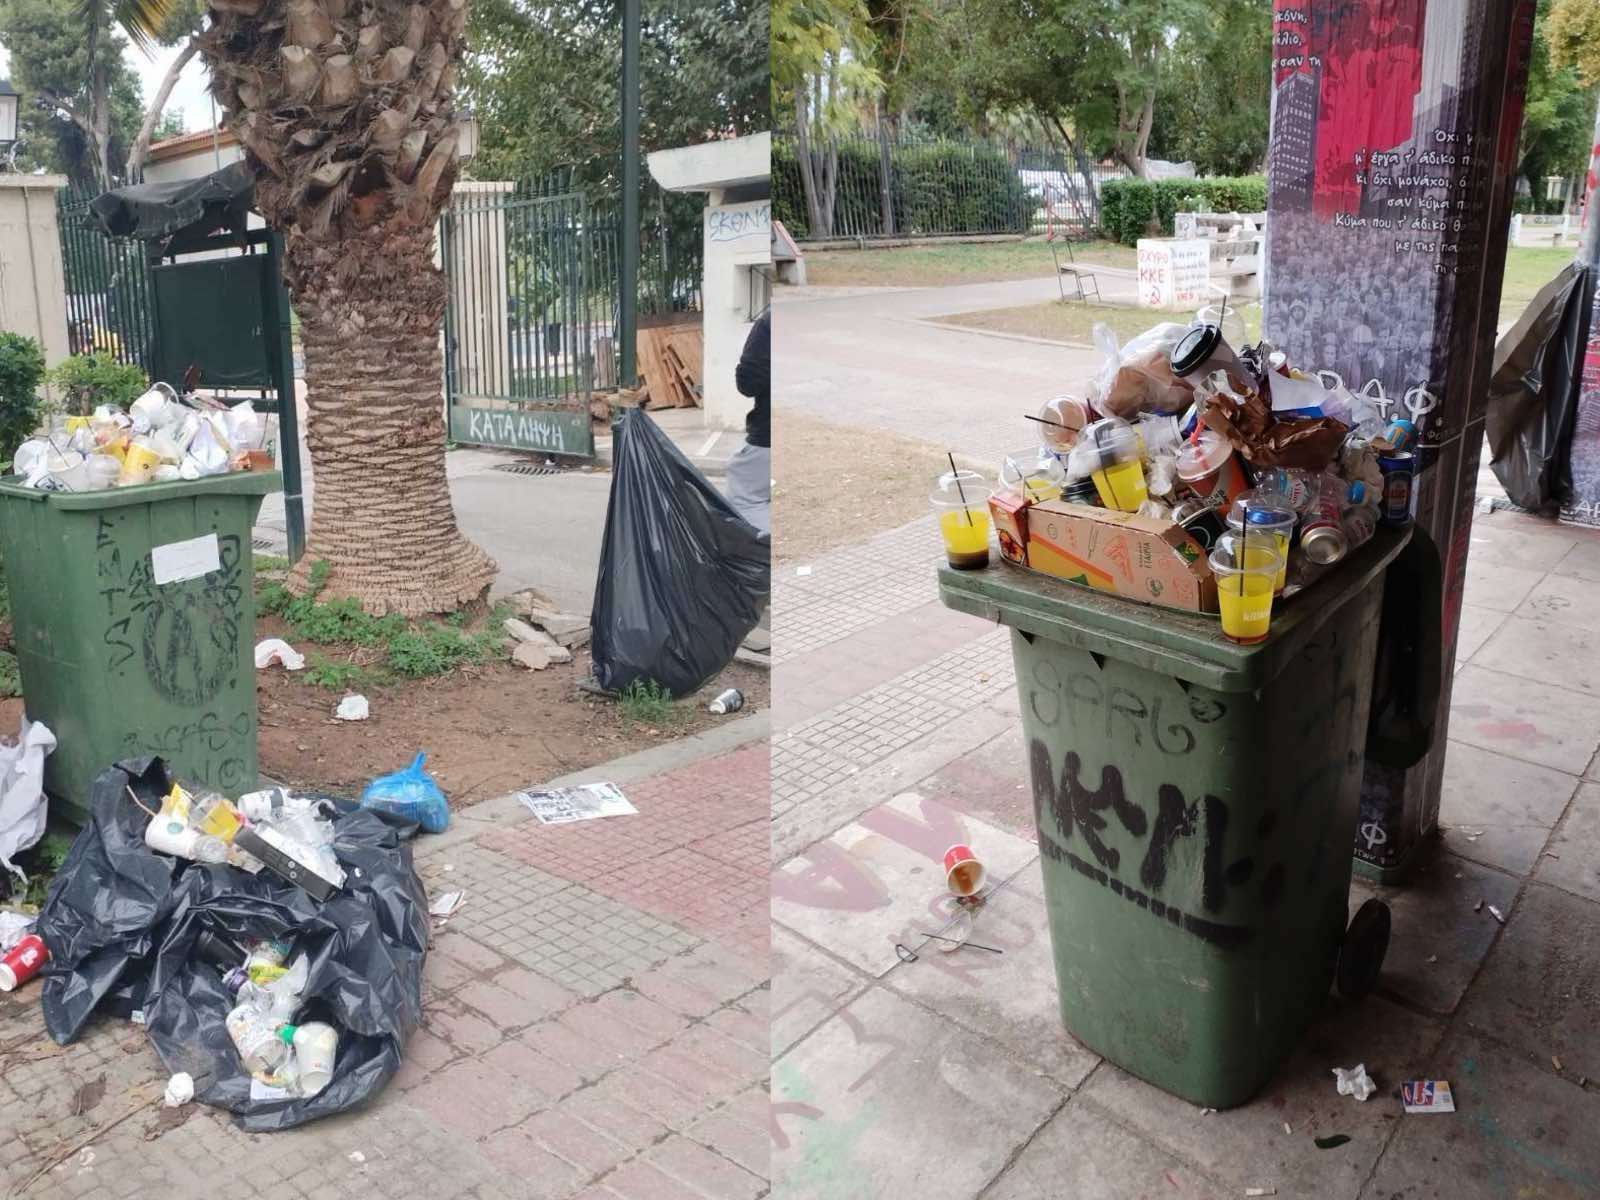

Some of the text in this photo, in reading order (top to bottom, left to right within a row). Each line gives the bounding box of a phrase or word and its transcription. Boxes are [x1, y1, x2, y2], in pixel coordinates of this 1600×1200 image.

[1280, 56, 1304, 67] σαν
[1309, 56, 1321, 67] τη
[1370, 152, 1399, 167] έργα
[1419, 151, 1456, 165] άδικο
[1355, 174, 1367, 185] κι
[1373, 174, 1392, 187] όχι
[1398, 174, 1452, 189] μονάχοι,
[1387, 197, 1413, 207] σαν
[1418, 197, 1450, 211] κύμα
[1335, 212, 1367, 227] Κύμα
[1372, 218, 1392, 228] που
[1411, 217, 1446, 231] άδικο
[1395, 240, 1410, 253] με
[1415, 240, 1436, 253] της
[1140, 267, 1165, 284] ΚΚΕ
[470, 408, 565, 451] ΚΑΤΑΛΗΨΗ
